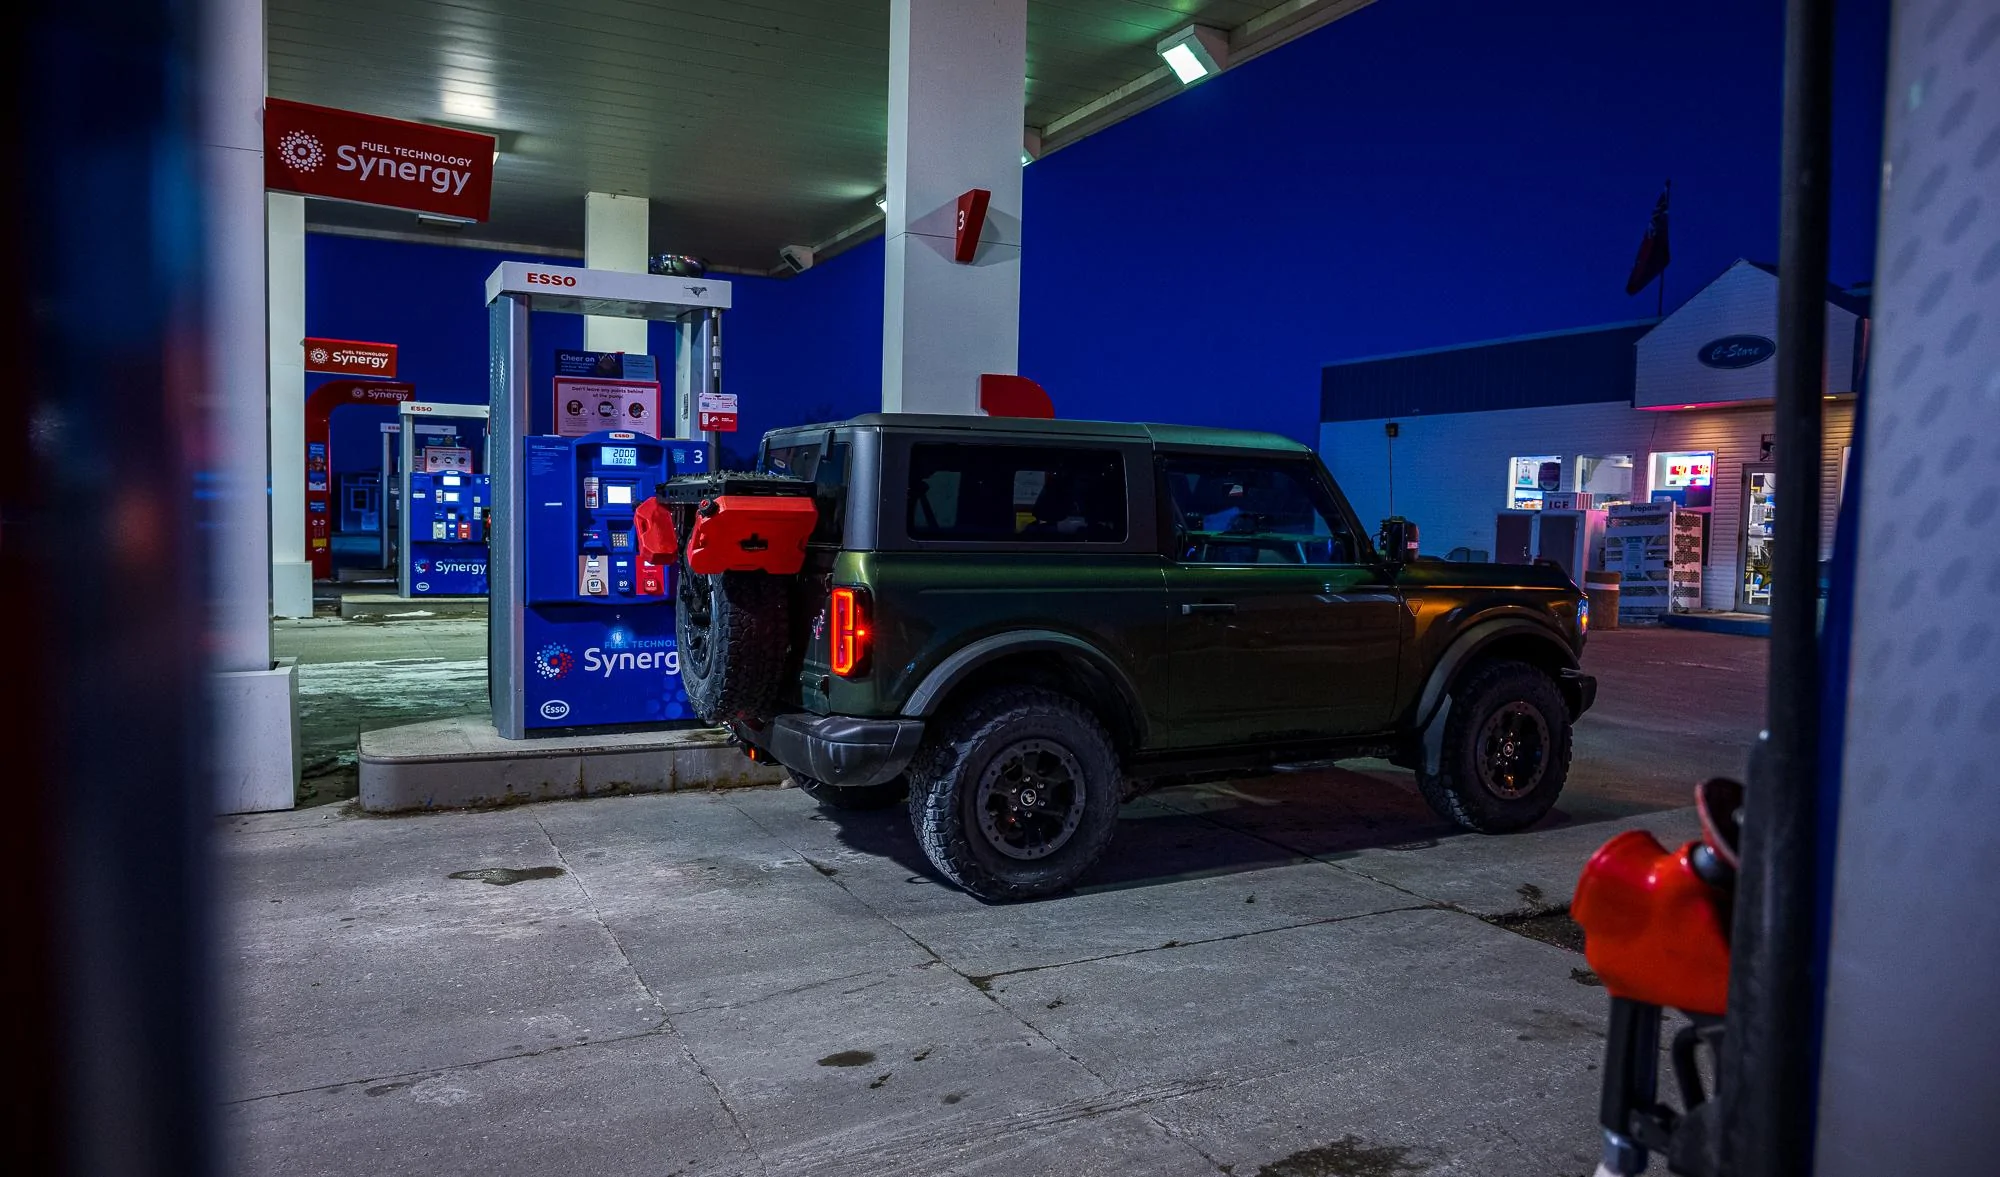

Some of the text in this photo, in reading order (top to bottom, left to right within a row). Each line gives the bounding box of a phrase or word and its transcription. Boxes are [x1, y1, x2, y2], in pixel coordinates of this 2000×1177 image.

[361, 141, 472, 167] FUEL TECHNOLOGY
[336, 144, 471, 196] Synergy
[958, 210, 965, 230] 3
[527, 272, 576, 287] ESSO
[332, 351, 388, 368] Synergy
[367, 389, 408, 400] Synergy
[693, 449, 703, 463] 3
[1549, 501, 1569, 509] ICE
[1630, 504, 1660, 513] Propane
[435, 561, 487, 575] Synergy
[605, 640, 678, 649] FUEL TECHNOL
[584, 648, 680, 678] Synerg
[545, 705, 566, 713] Esso
